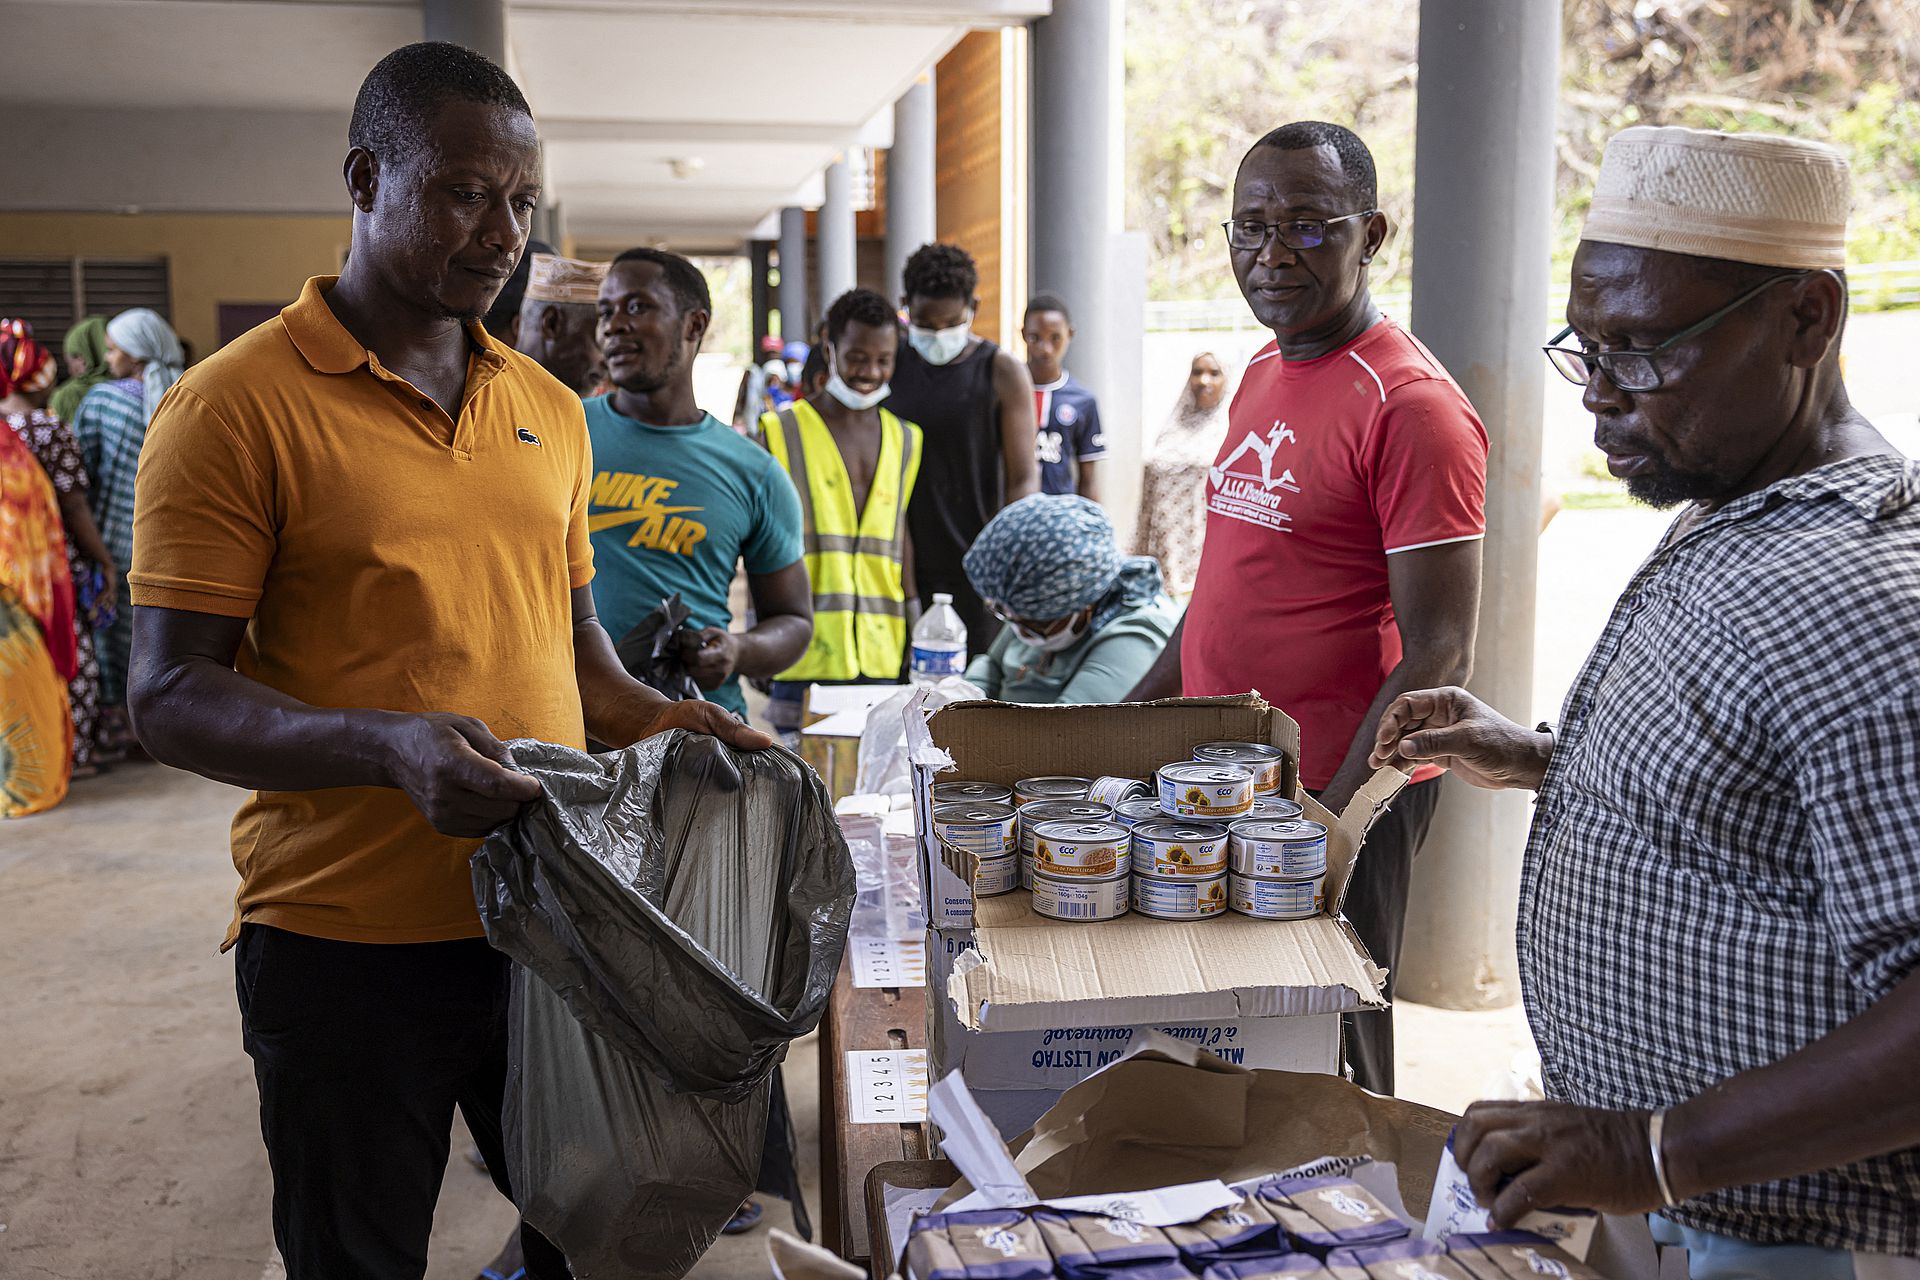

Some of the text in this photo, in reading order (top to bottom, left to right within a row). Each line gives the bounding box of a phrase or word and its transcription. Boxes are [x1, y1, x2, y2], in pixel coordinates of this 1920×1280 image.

[589, 471, 679, 509] NIKE
[627, 513, 707, 557] AIR
[1043, 1027, 1133, 1046] tournesol
[1031, 1049, 1092, 1068] LISTAO
